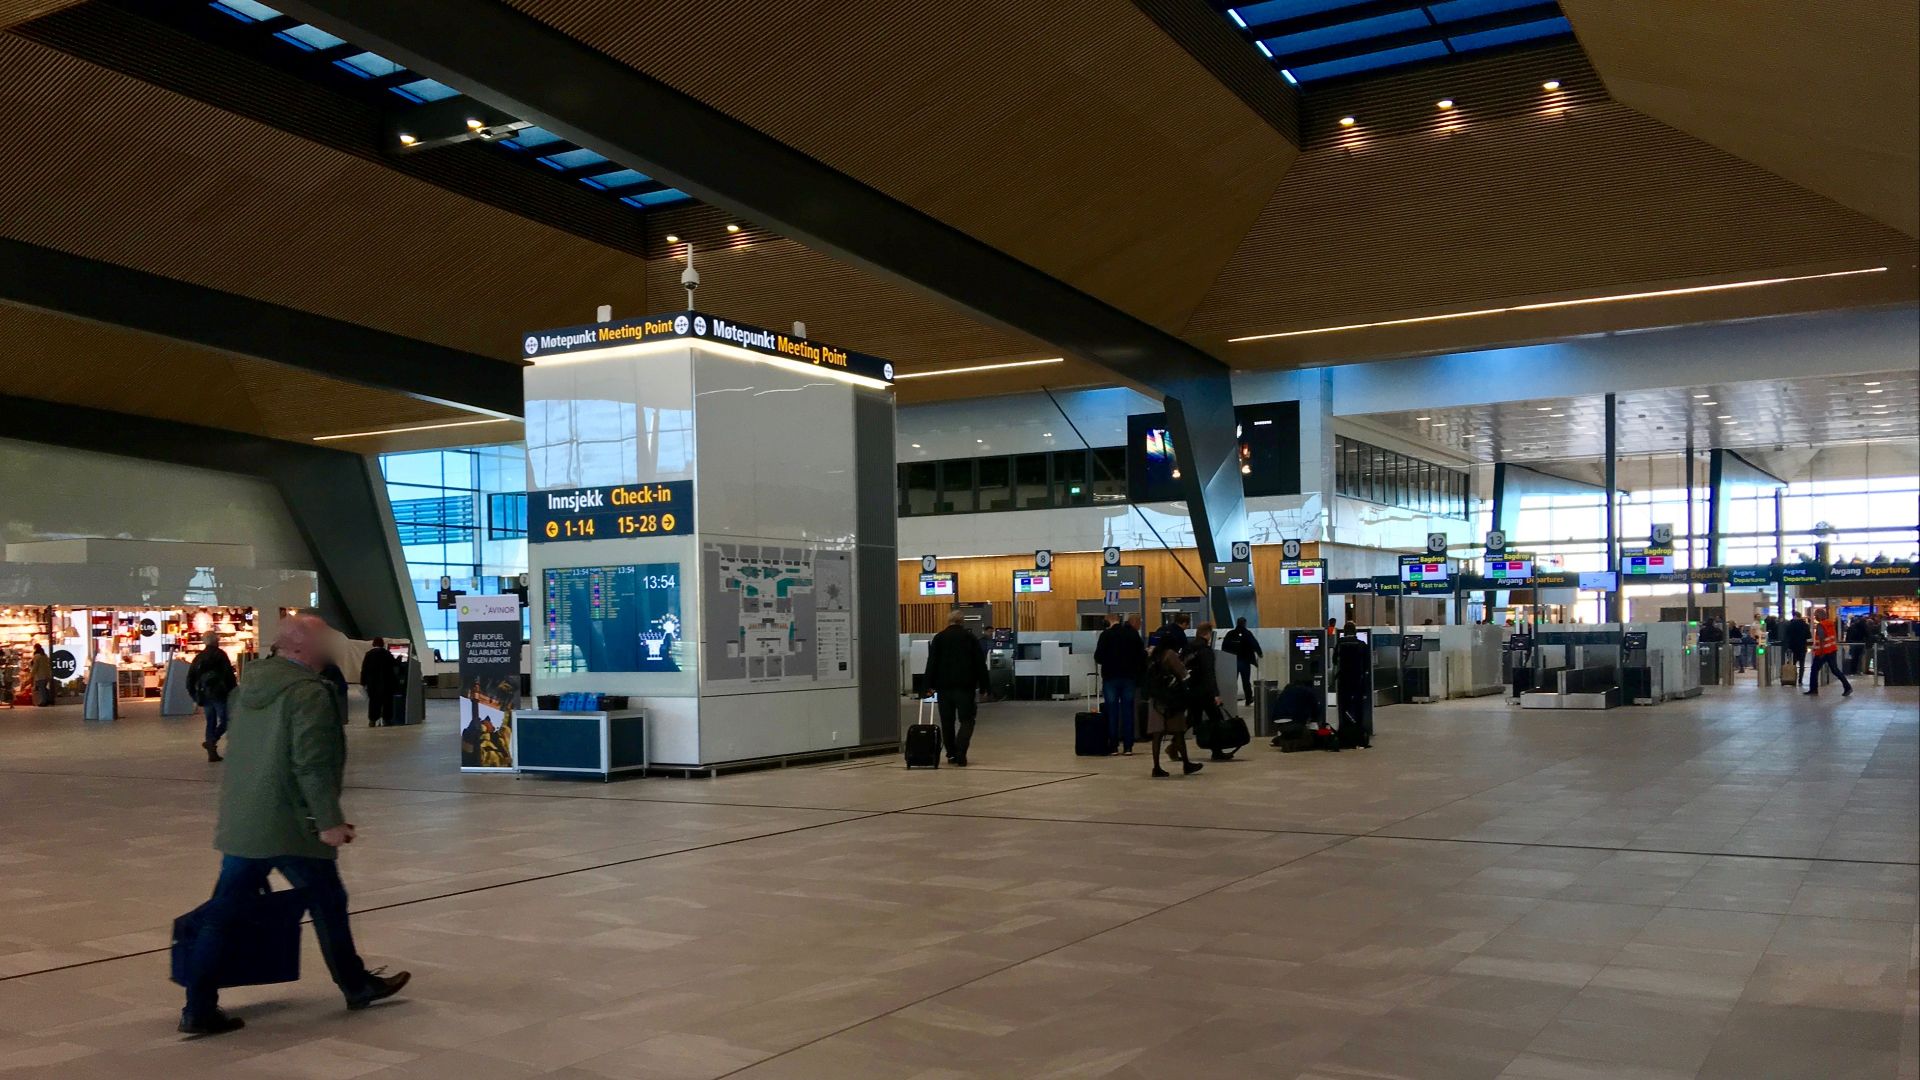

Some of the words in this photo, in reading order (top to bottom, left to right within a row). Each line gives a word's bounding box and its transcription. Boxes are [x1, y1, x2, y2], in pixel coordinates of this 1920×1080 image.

[540, 330, 596, 348] Møtepunkt
[598, 324, 642, 340] Meeting
[644, 320, 673, 334] Point
[713, 319, 776, 348] Møtepunkt
[778, 336, 820, 364] Meeting
[822, 346, 848, 366] Point
[548, 490, 604, 512] Innsjekk
[611, 484, 671, 506] Check-in
[564, 519, 594, 536] 1-14
[618, 516, 657, 533] 15-28
[1656, 528, 1670, 538] 14
[1432, 538, 1444, 547] 12
[1490, 536, 1502, 546] 13
[1236, 546, 1246, 555] 10
[1286, 544, 1296, 553] 11
[1041, 555, 1046, 563] 8
[1109, 552, 1115, 560] 9
[1830, 567, 1861, 577] Avgang
[1864, 567, 1910, 576] Departures
[642, 574, 676, 589] 13:54
